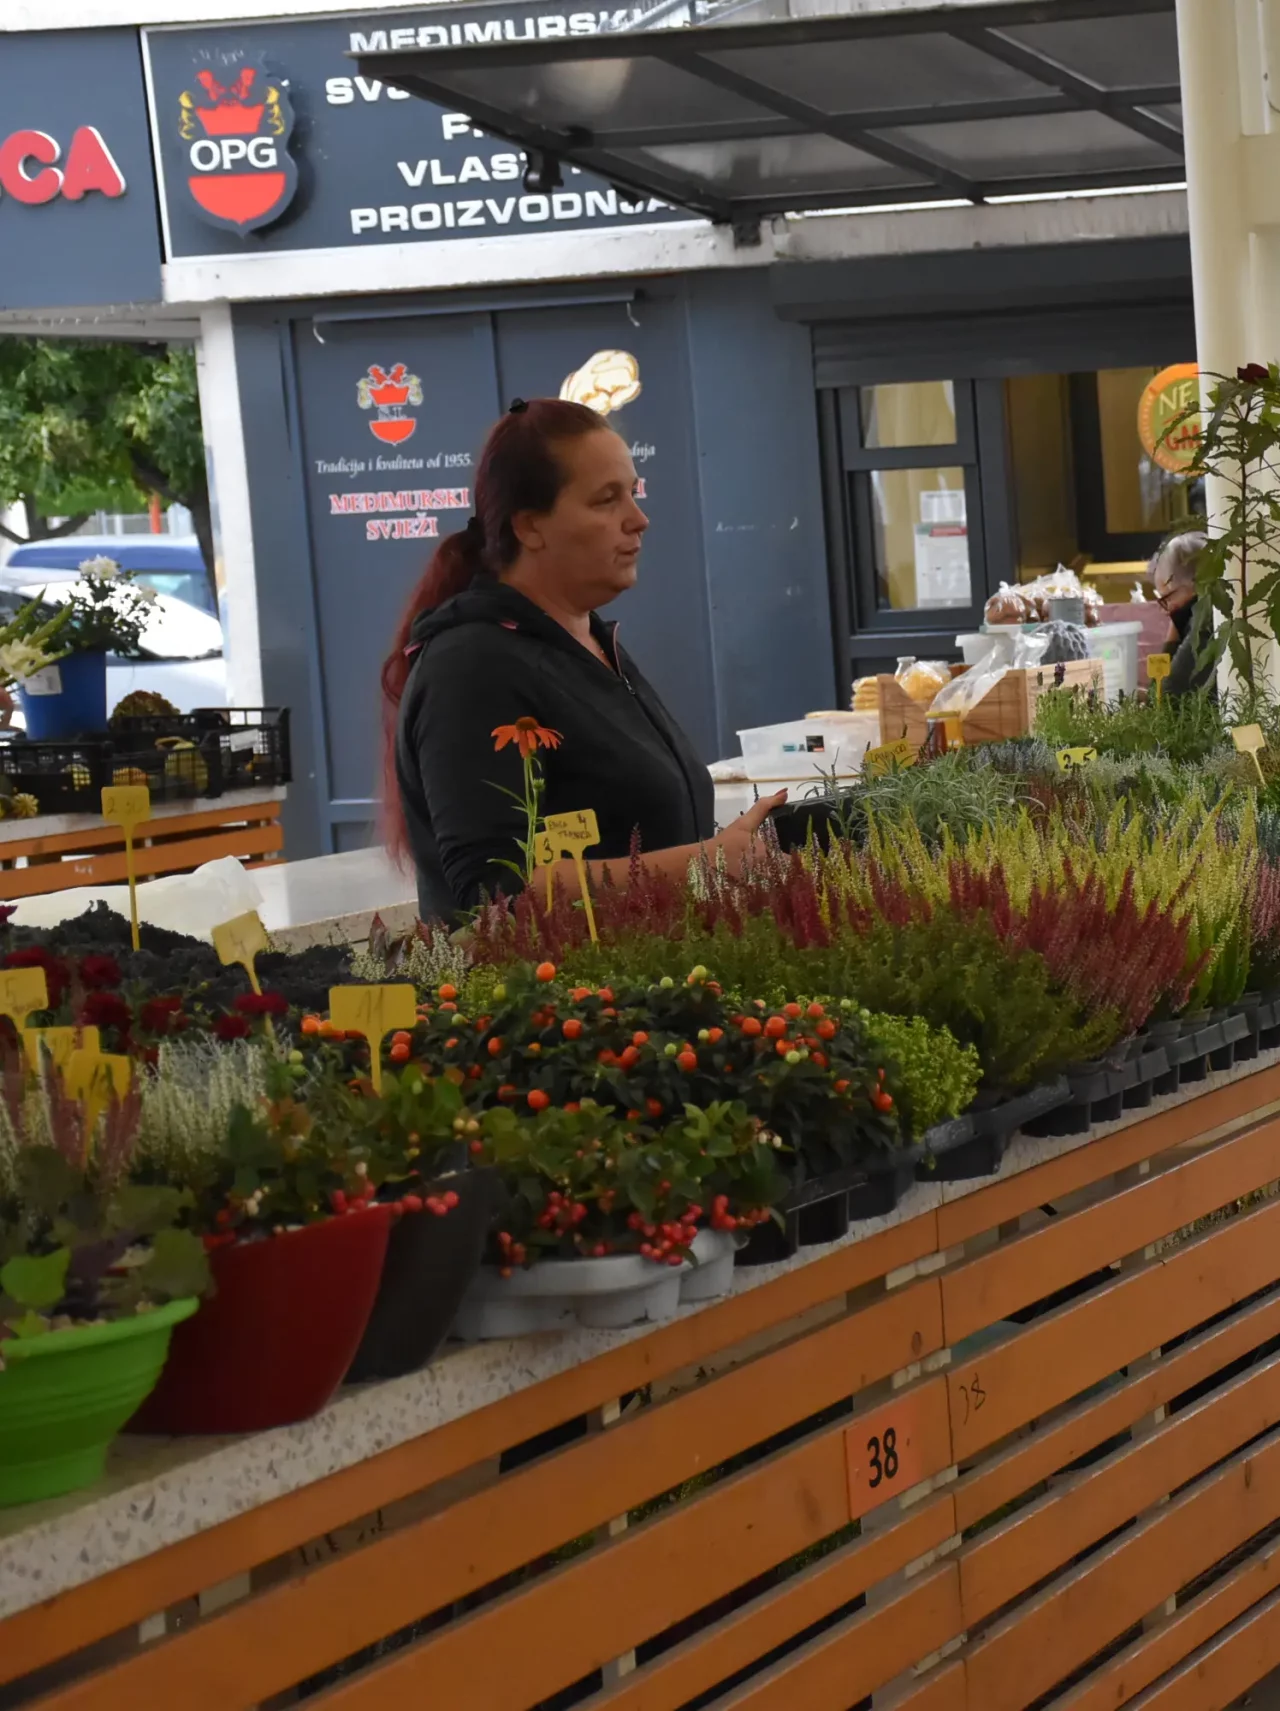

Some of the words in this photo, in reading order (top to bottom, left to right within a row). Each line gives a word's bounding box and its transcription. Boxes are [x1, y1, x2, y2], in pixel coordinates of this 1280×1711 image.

[190, 136, 277, 171] OPG
[1164, 424, 1202, 452] GM
[315, 456, 366, 479] Tradicija
[375, 454, 424, 471] kvaliteta
[426, 452, 443, 469] od
[329, 487, 471, 515] MEĐIMURSKI
[366, 511, 440, 542] SVJEŽI
[866, 1426, 899, 1489] 38
